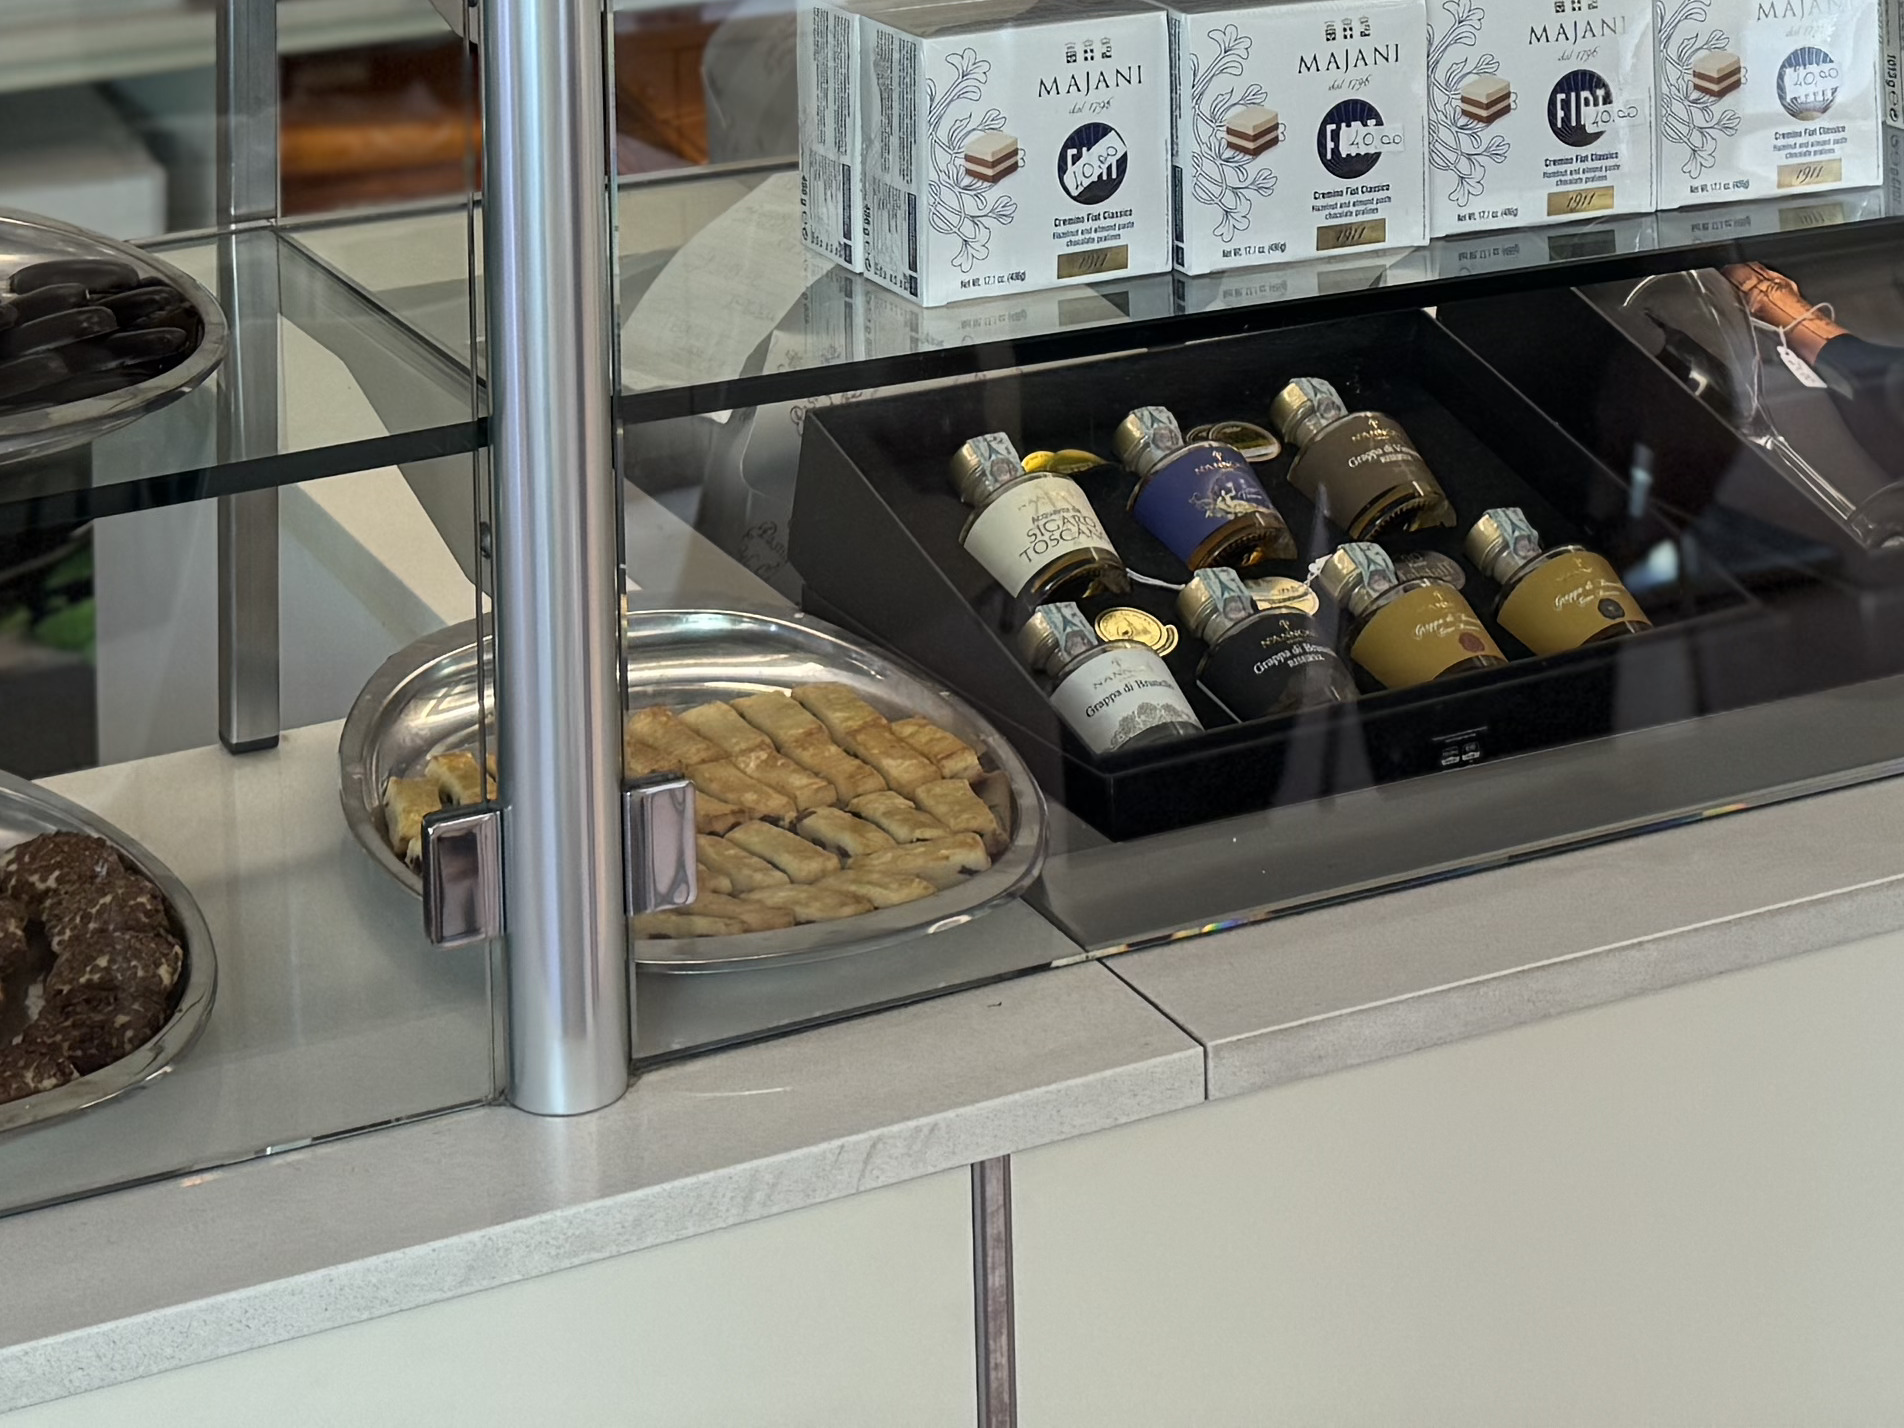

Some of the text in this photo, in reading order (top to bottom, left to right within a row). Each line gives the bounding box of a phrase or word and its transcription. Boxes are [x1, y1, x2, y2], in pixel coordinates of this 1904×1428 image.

[1529, 16, 1626, 45] MAJANI
[1298, 44, 1399, 74] MAJANI
[1038, 65, 1143, 98] MAJANI
[1796, 166, 1823, 184] 1911
[1566, 192, 1596, 212] 1911
